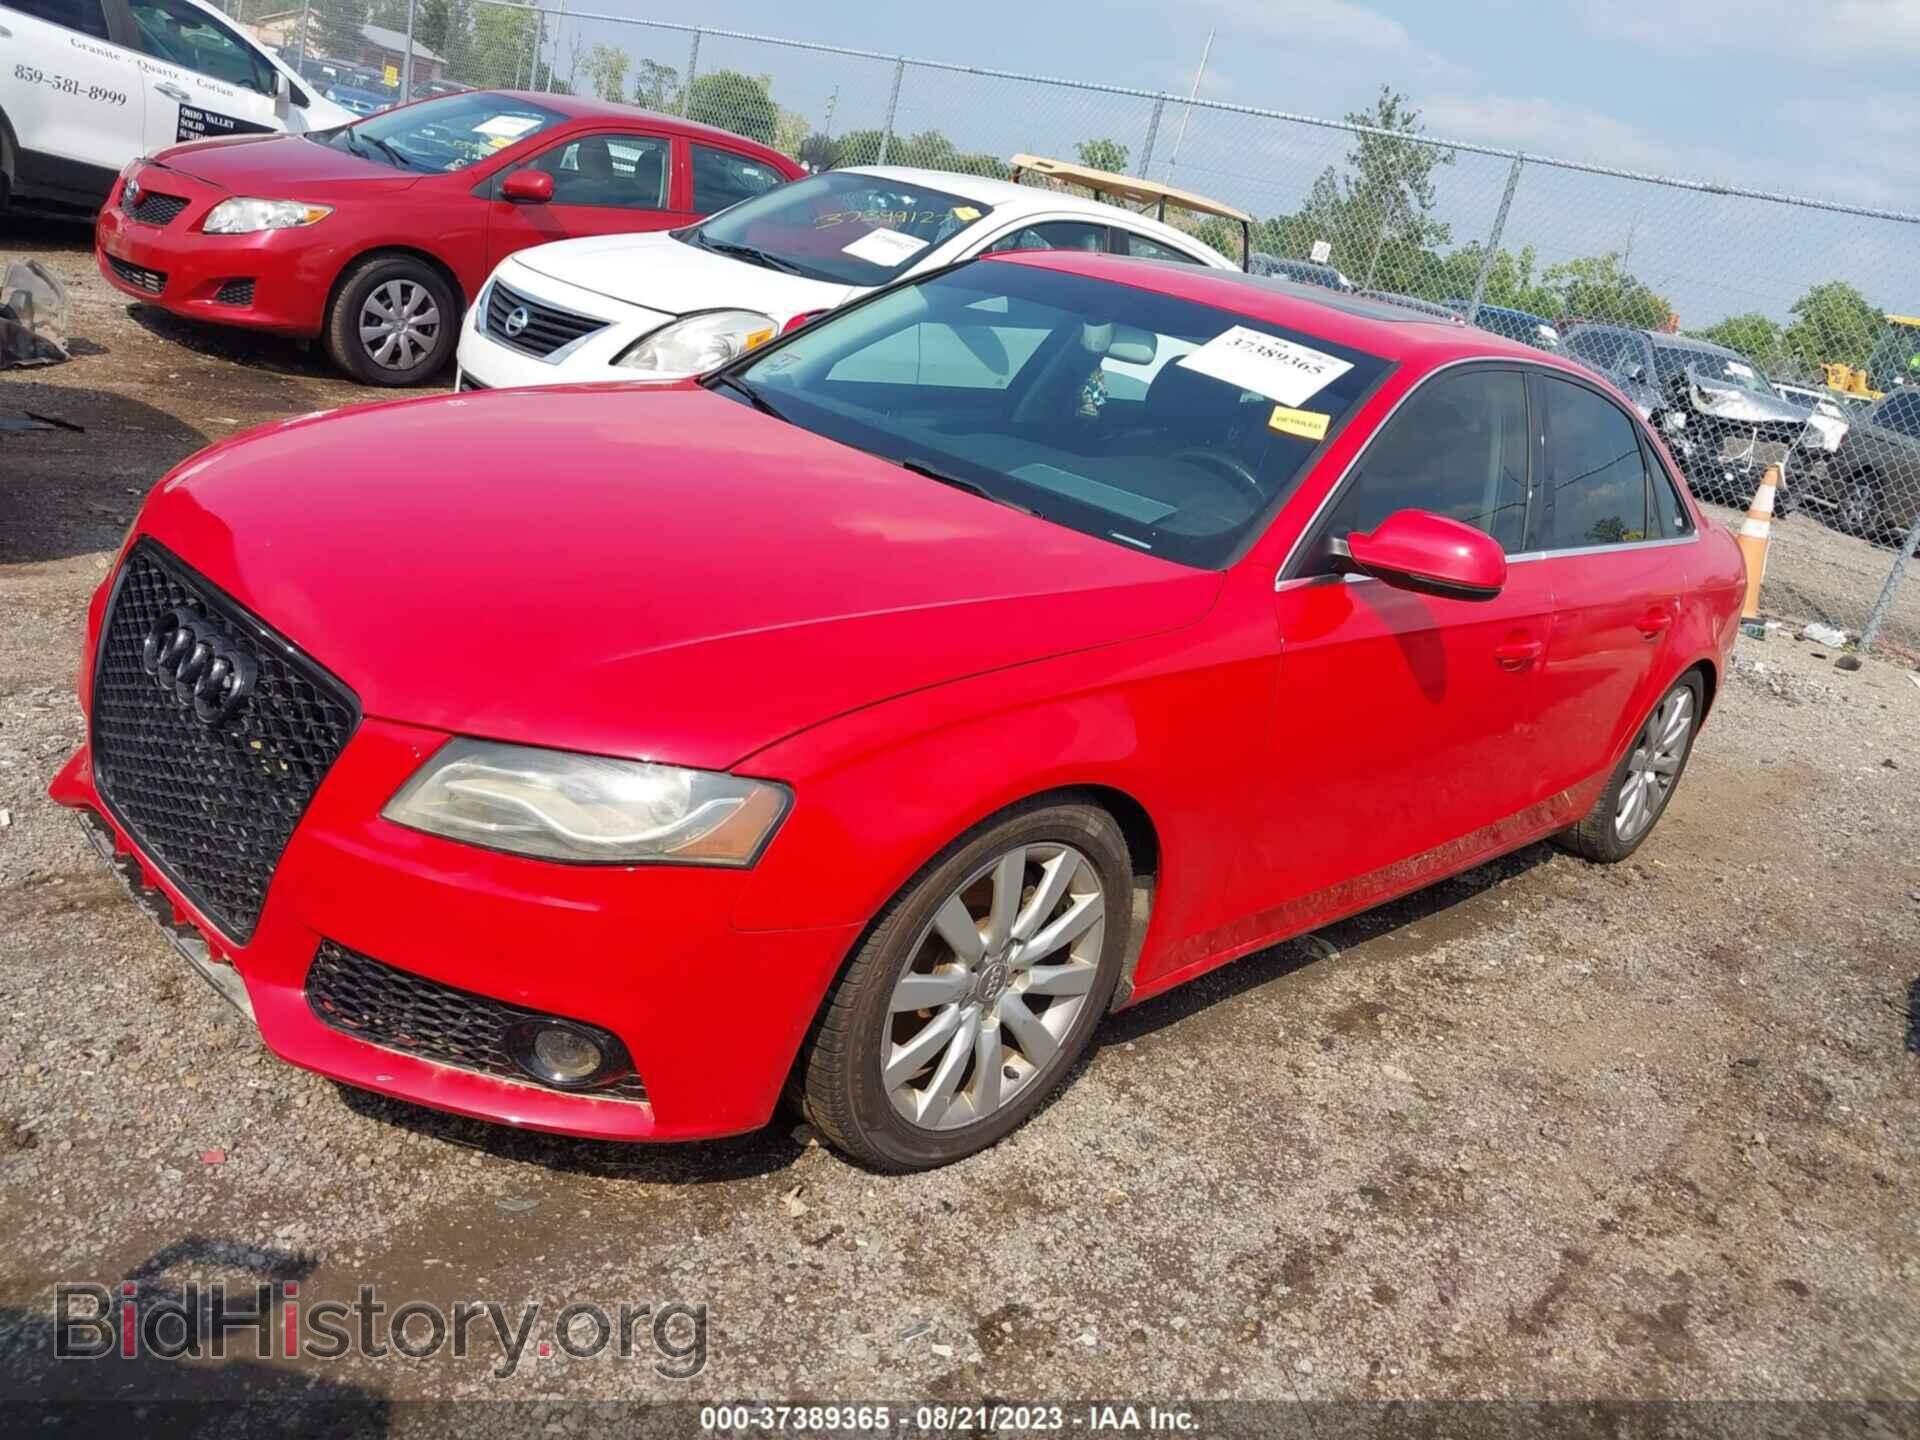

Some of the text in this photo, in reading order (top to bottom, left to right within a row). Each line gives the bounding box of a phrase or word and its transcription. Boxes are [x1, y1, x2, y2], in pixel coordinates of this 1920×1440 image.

[14, 63, 128, 107] 859-581-8999
[70, 37, 121, 61] Granite
[137, 59, 180, 81] Quartz
[196, 77, 234, 97] Corian
[180, 117, 205, 132] SOLID
[181, 106, 235, 129] OHIO VALLEY
[1227, 337, 1326, 375] 37389365
